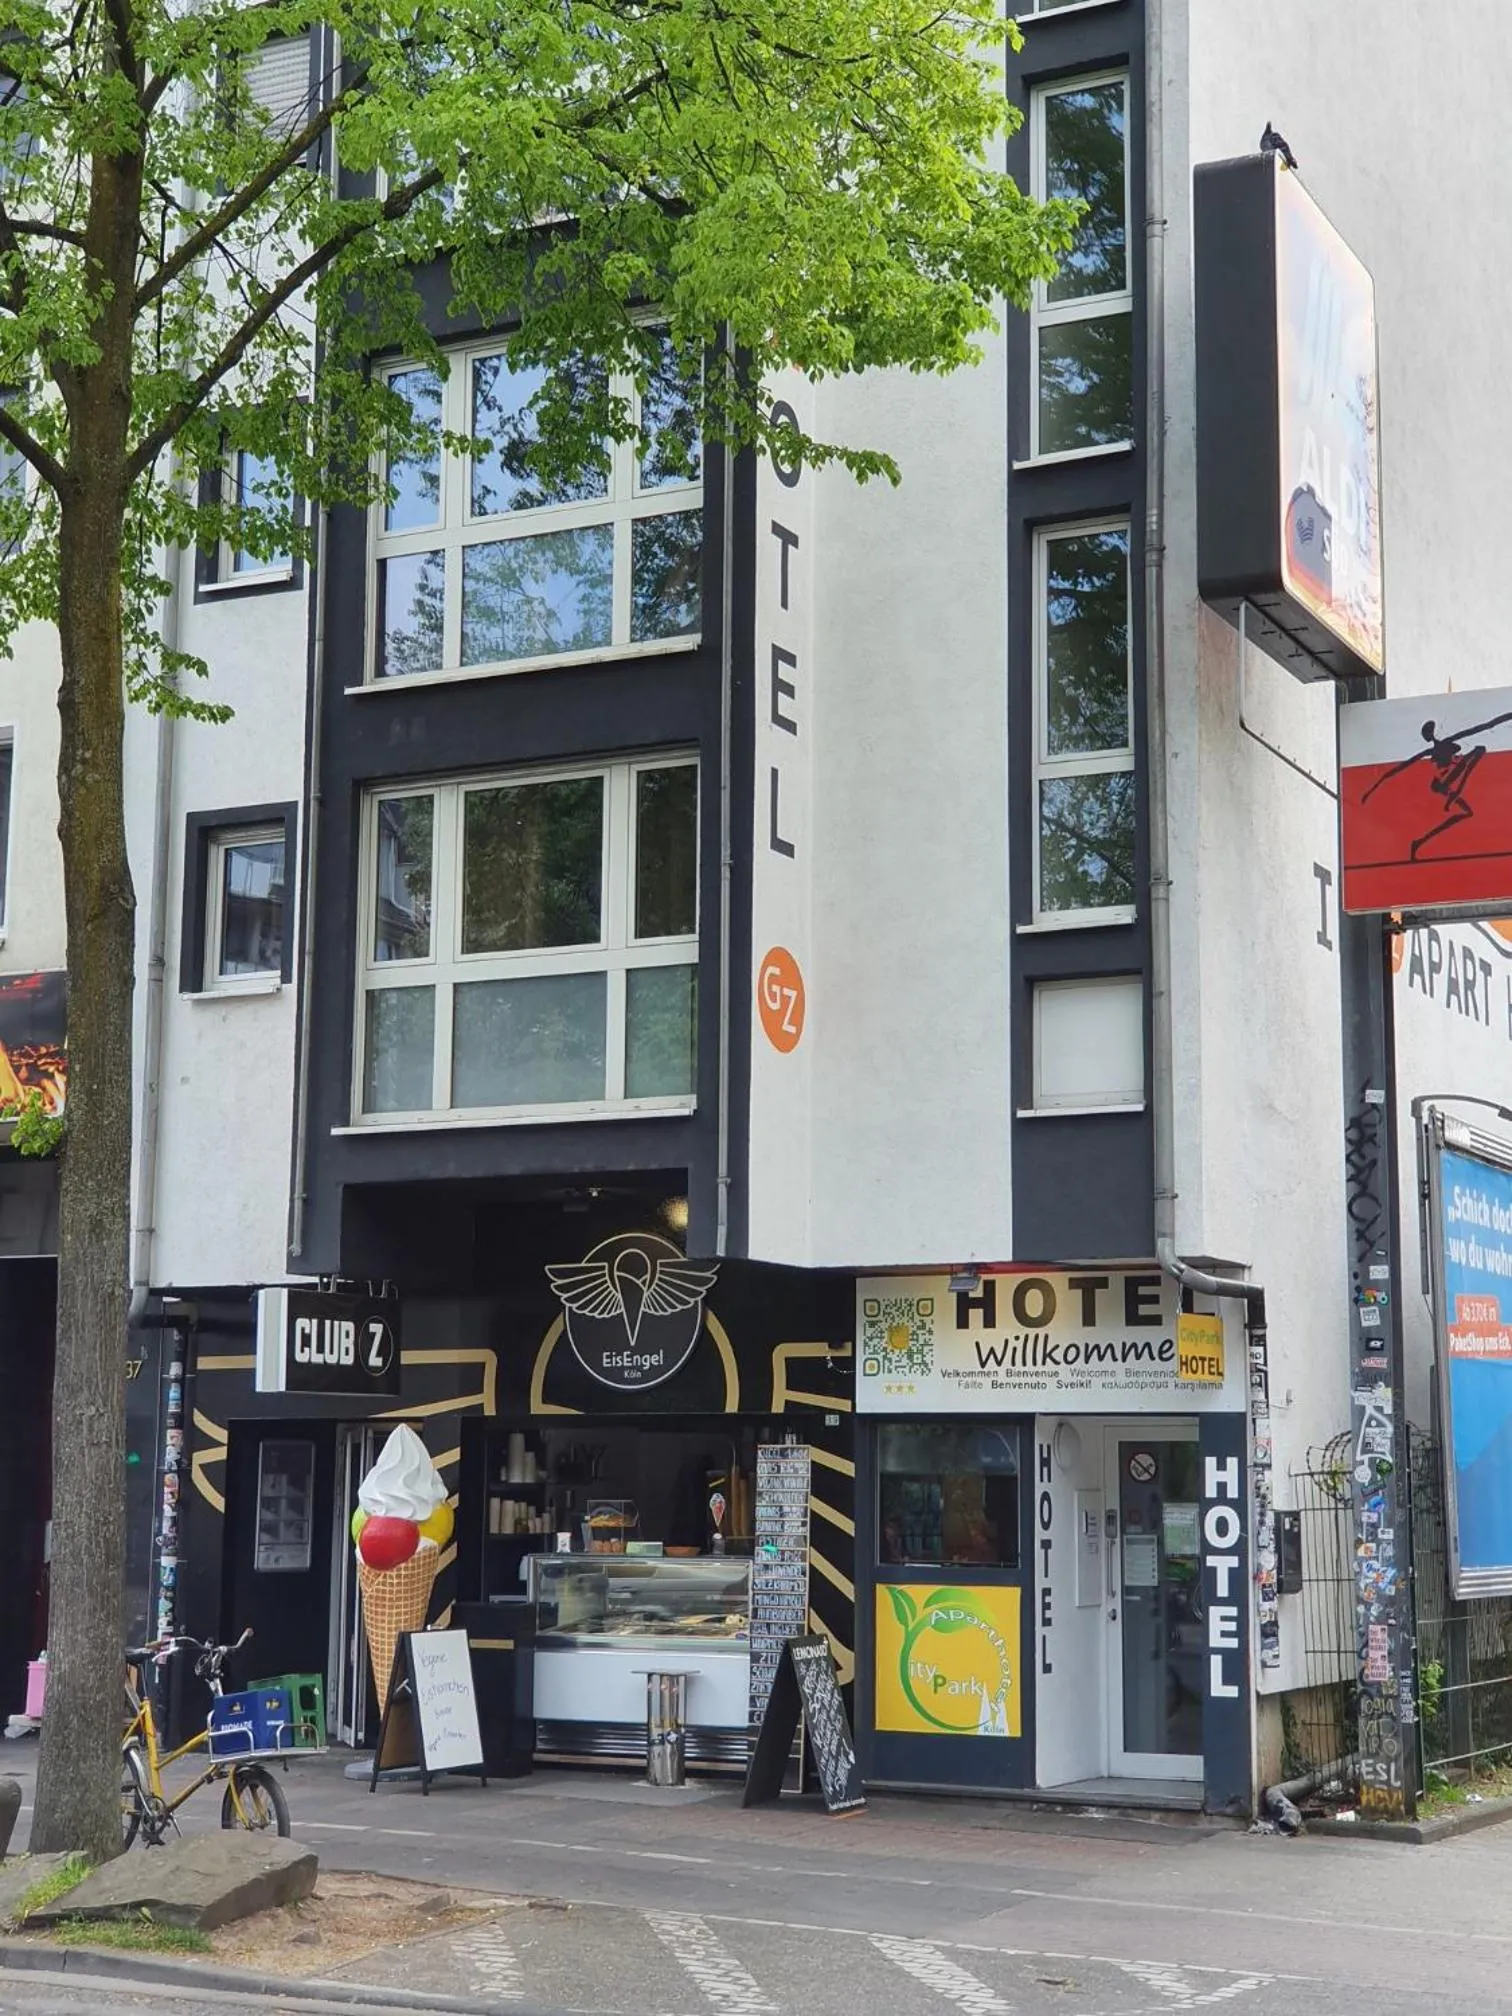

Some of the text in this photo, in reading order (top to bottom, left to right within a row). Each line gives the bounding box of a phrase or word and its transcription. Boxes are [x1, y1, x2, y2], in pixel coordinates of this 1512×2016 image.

[1408, 927, 1492, 1026] APART
[761, 966, 798, 1035] GZ
[1449, 1237, 1466, 1265] wo
[1469, 1236, 1484, 1270] du
[295, 1317, 384, 1368] CLUB Z
[602, 1349, 664, 1370] EisEngel
[974, 1333, 1175, 1370] Willkomme
[941, 1368, 999, 1379] Velkommen
[1005, 1368, 1060, 1379] Bienvenue
[1069, 1368, 1117, 1379] Welcome
[1179, 1354, 1224, 1378] HOTEL
[991, 1380, 1048, 1391] Benvenuto
[1056, 1379, 1092, 1391] Sveiki!
[1037, 1444, 1054, 1675] HOTEL
[1203, 1456, 1240, 1699] HOTEL
